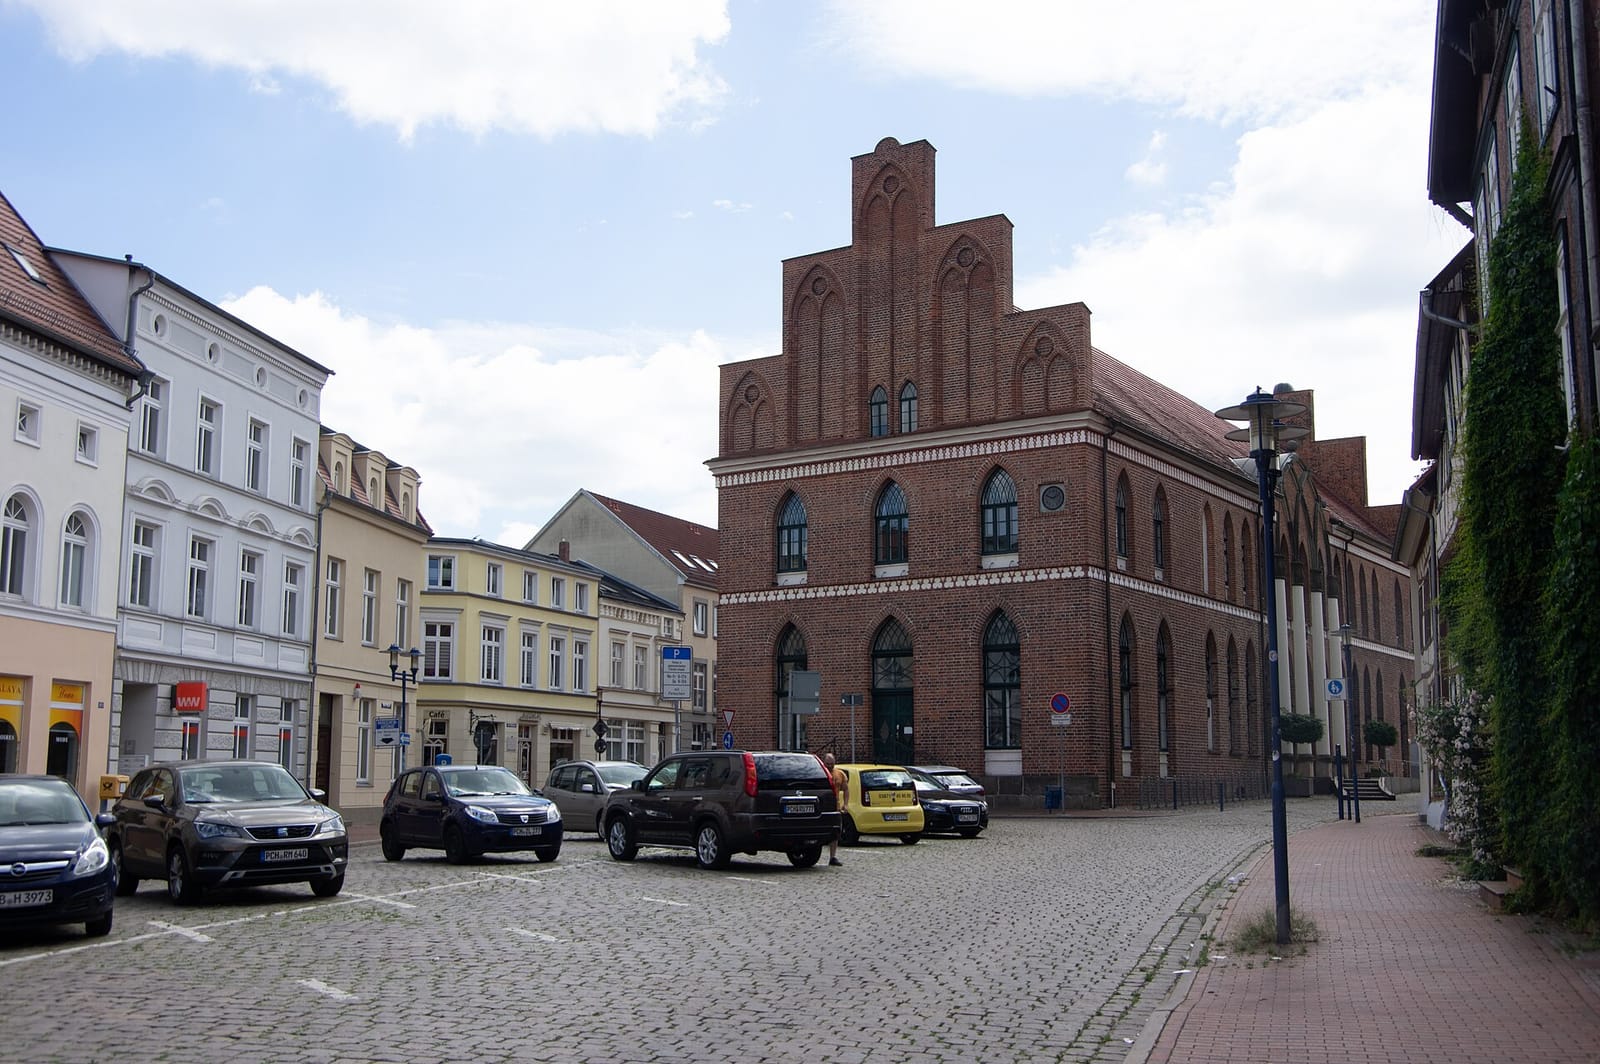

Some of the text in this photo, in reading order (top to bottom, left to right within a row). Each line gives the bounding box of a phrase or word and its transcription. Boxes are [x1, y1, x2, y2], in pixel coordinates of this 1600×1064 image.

[673, 649, 680, 659] P
[429, 711, 445, 719] Café
[266, 850, 280, 860] PCH
[14, 893, 21, 904] H
[24, 890, 52, 903] 3973
